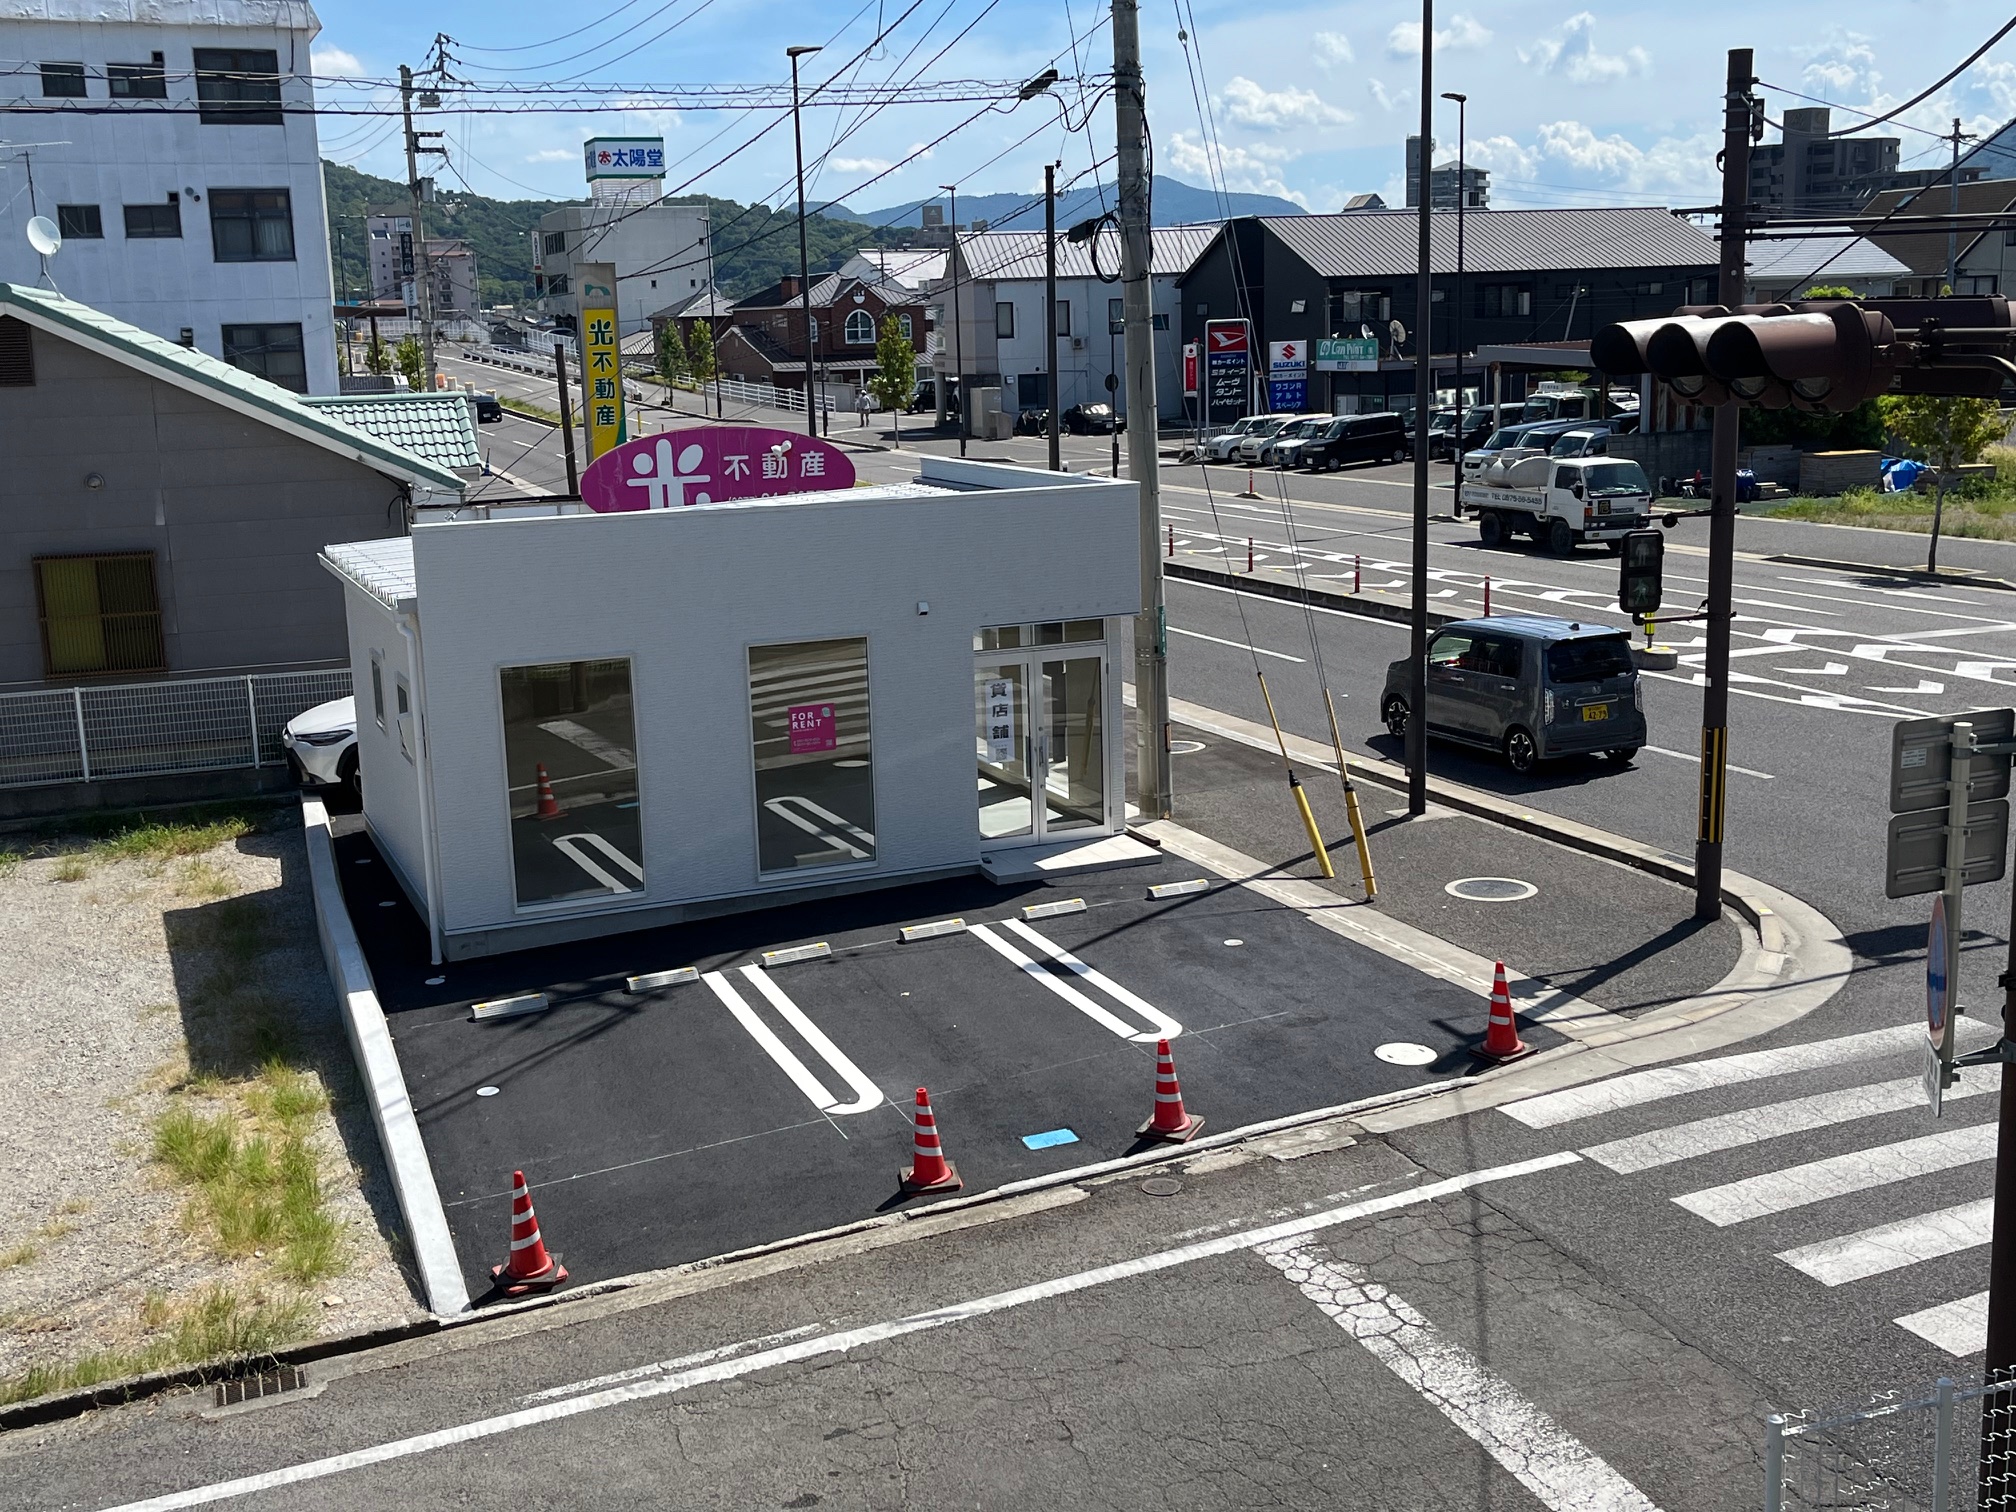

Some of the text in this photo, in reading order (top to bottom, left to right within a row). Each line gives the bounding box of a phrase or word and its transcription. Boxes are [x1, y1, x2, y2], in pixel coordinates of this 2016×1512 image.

[612, 148, 664, 168] 太陽堂
[1273, 361, 1305, 369] SUZUKI
[588, 319, 615, 426] 光不動産
[1216, 378, 1241, 387] ムーヴ
[1275, 382, 1302, 391] ワゴンR
[1215, 388, 1242, 397] タント
[1275, 391, 1302, 400] アルト
[1211, 398, 1247, 406] ハイゼット
[1275, 401, 1302, 410] スペーシア
[723, 450, 826, 482] 不動産
[1491, 493, 1501, 501] TEL
[791, 712, 814, 721] FOR
[792, 719, 822, 730] RENT
